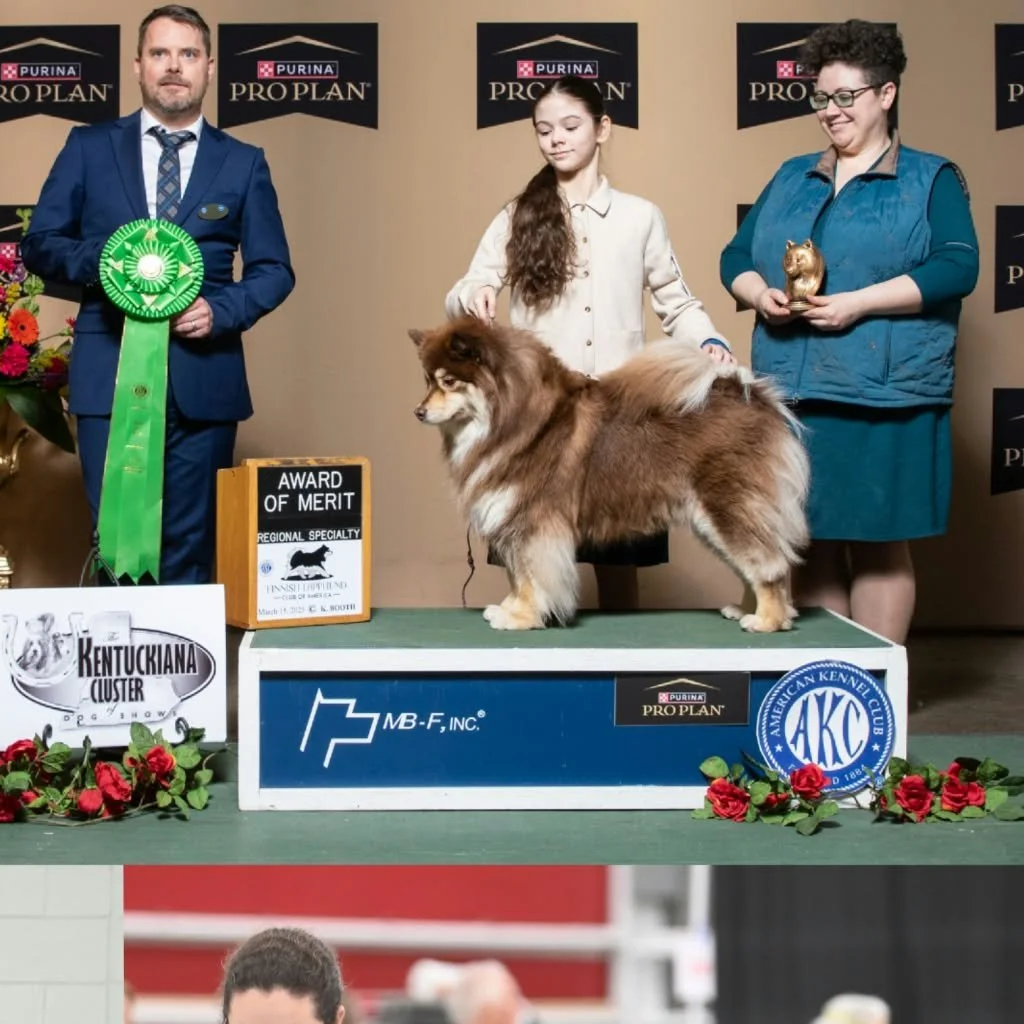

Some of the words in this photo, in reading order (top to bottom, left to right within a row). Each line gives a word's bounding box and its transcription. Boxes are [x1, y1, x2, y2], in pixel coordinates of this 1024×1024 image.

[20, 66, 76, 77] PURINA
[276, 64, 334, 75] PURINA
[536, 63, 593, 74] PURINA
[229, 82, 287, 101] PRO
[749, 82, 807, 101] PRO
[278, 471, 343, 490] AWARD
[264, 494, 290, 513] OF
[298, 492, 355, 512] MERIT
[257, 531, 305, 543] REGIONAL
[308, 528, 360, 541] SPECIALTY
[78, 636, 198, 677] KENTUCKIANA
[90, 678, 145, 703] CLUSTER
[642, 705, 676, 716] PRO
[769, 673, 815, 737] AMERICAN
[818, 670, 871, 699] KENNEL
[867, 698, 884, 736] CLUB
[790, 690, 864, 768] AKC
